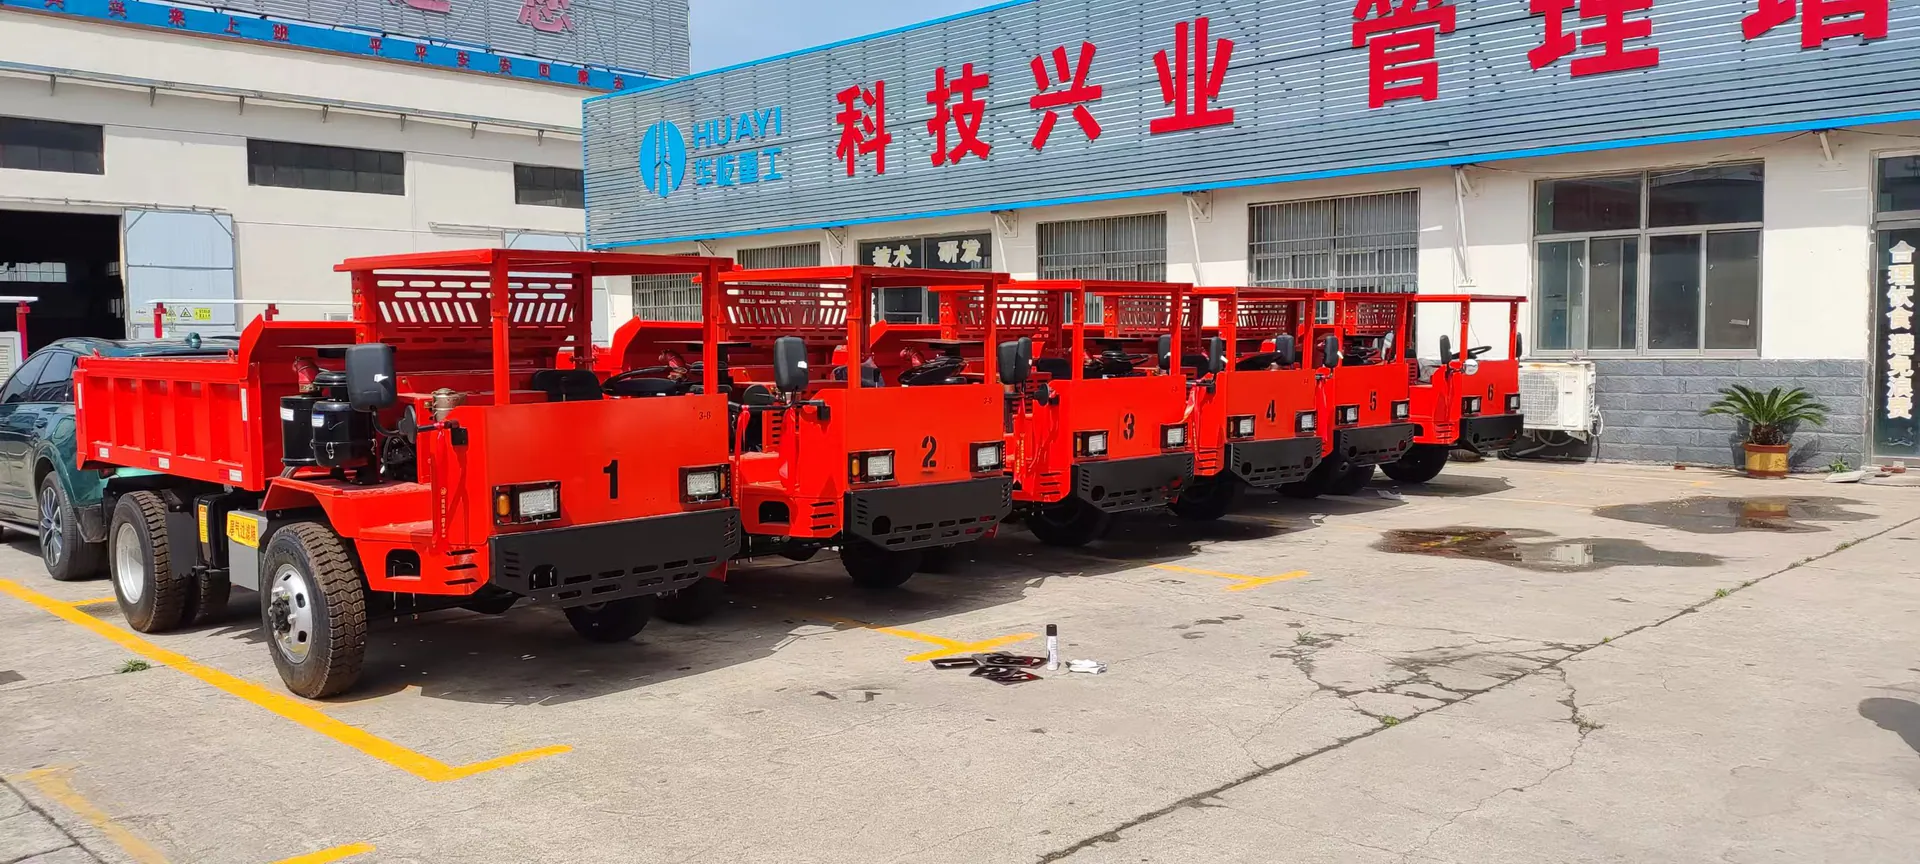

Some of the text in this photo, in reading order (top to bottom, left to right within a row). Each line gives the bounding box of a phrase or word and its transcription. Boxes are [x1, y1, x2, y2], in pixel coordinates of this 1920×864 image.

[836, 17, 1235, 176] 科技兴业
[693, 106, 783, 149] HUAYI
[937, 239, 982, 263] 研发
[1886, 240, 1916, 330] 合理饮食
[1369, 389, 1378, 412] 5
[1487, 383, 1495, 401] 6
[1122, 412, 1135, 441] 3
[1265, 399, 1276, 423] 4
[920, 435, 937, 469] 2
[602, 459, 619, 500] 1
